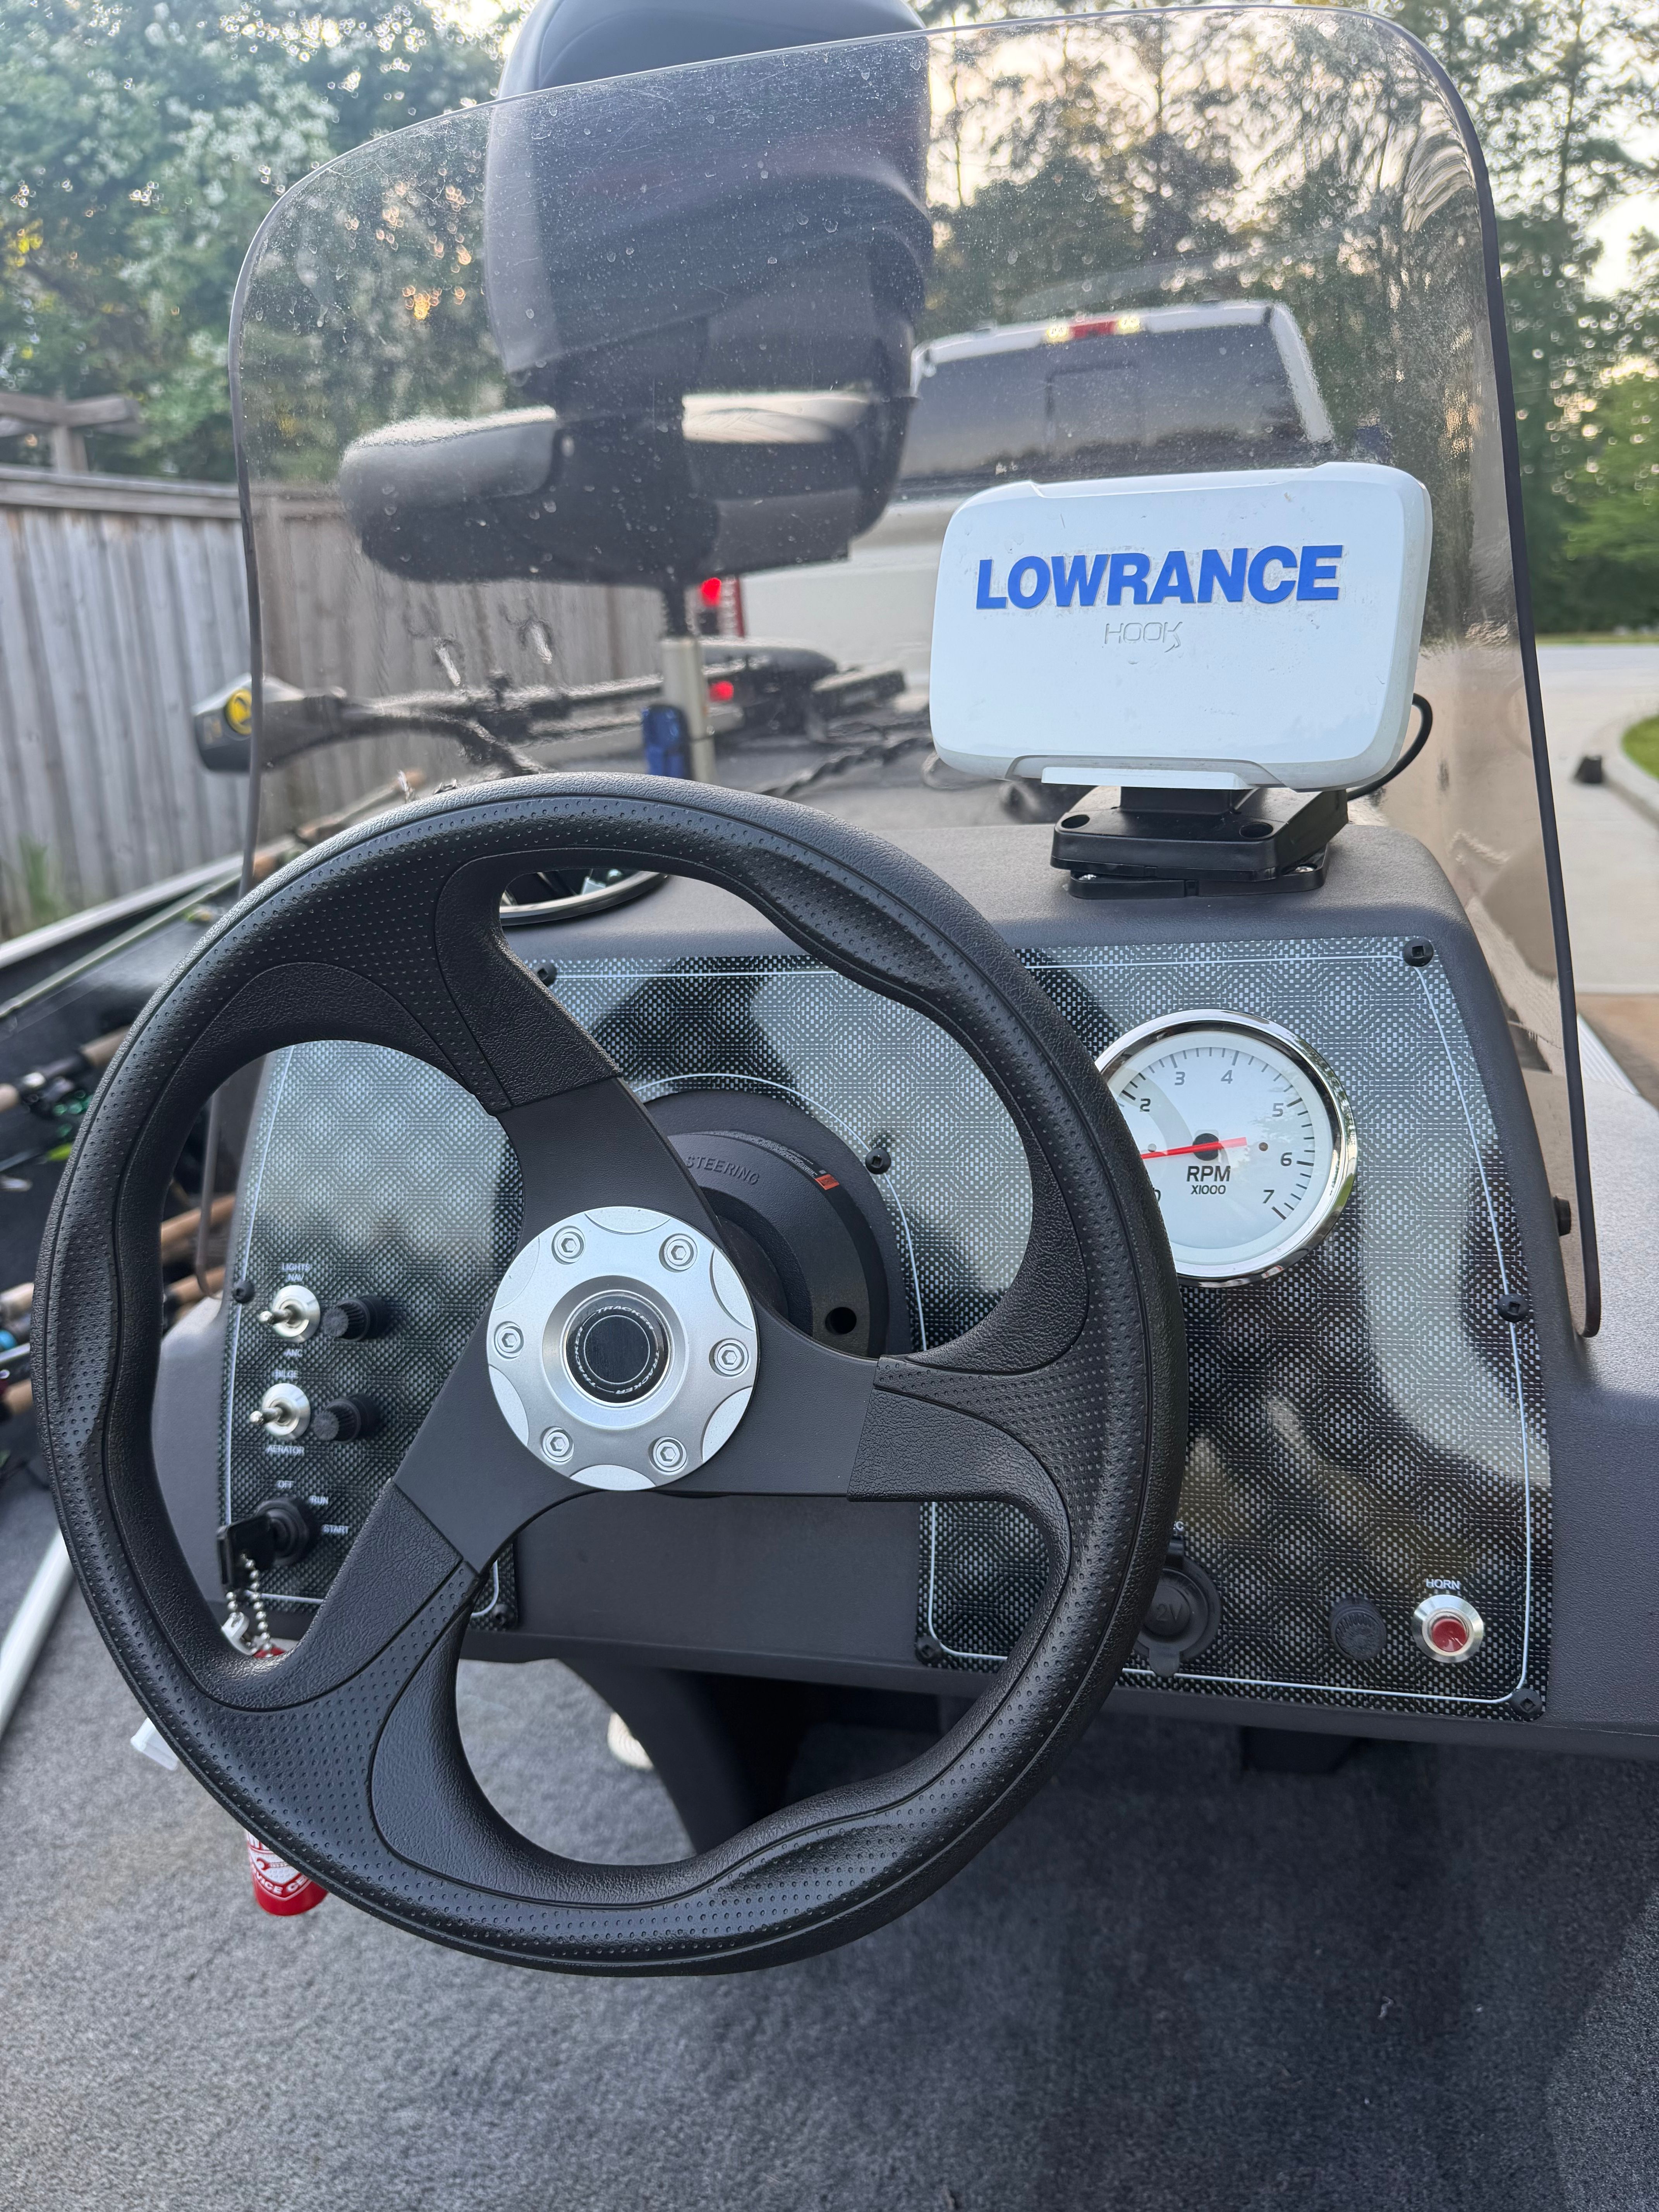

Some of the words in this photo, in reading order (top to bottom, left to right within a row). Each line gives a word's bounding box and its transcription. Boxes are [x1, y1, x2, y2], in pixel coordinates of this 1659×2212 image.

[976, 545, 1343, 610] LOWRANCE
[1104, 622, 1182, 652] HOOK
[1175, 1071, 1185, 1085] 3
[1220, 1070, 1233, 1084] 4
[1139, 1098, 1151, 1112] 2
[1272, 1103, 1284, 1117] 5
[1280, 1152, 1292, 1167] 6
[685, 1156, 760, 1186] STEERING
[1186, 1165, 1231, 1182] RPM
[1190, 1184, 1226, 1195] X1000
[1262, 1189, 1274, 1204] 7
[282, 1262, 310, 1272] LIGHTS
[288, 1273, 304, 1281] NAV
[596, 1305, 654, 1330] TRACKER
[575, 1326, 596, 1387] TRACKER
[274, 1369, 299, 1379] BILGE
[615, 1350, 660, 1395] TRACKER
[266, 1446, 305, 1455] AERATOR
[277, 1480, 294, 1489] OFF
[310, 1495, 329, 1504] RUN
[322, 1524, 349, 1534] START
[1425, 1578, 1460, 1590] HORN
